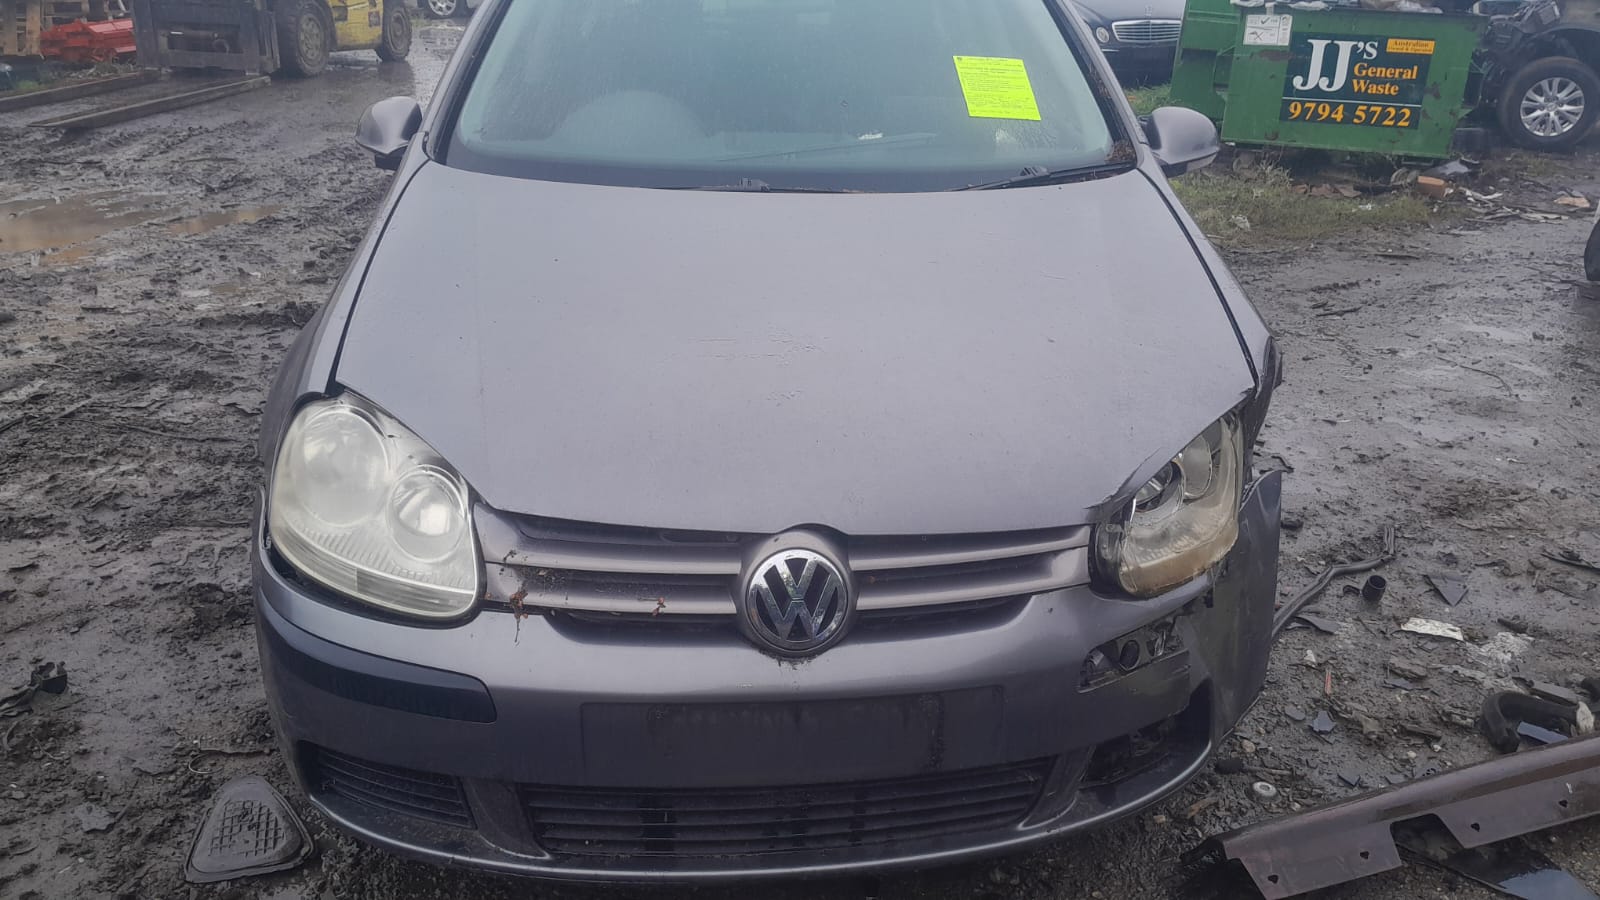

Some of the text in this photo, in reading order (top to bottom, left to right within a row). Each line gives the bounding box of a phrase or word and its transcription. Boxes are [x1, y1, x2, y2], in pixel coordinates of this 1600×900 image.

[1354, 62, 1418, 79] General
[1352, 80, 1399, 95] Waste
[1288, 101, 1411, 127] 9794 5722
